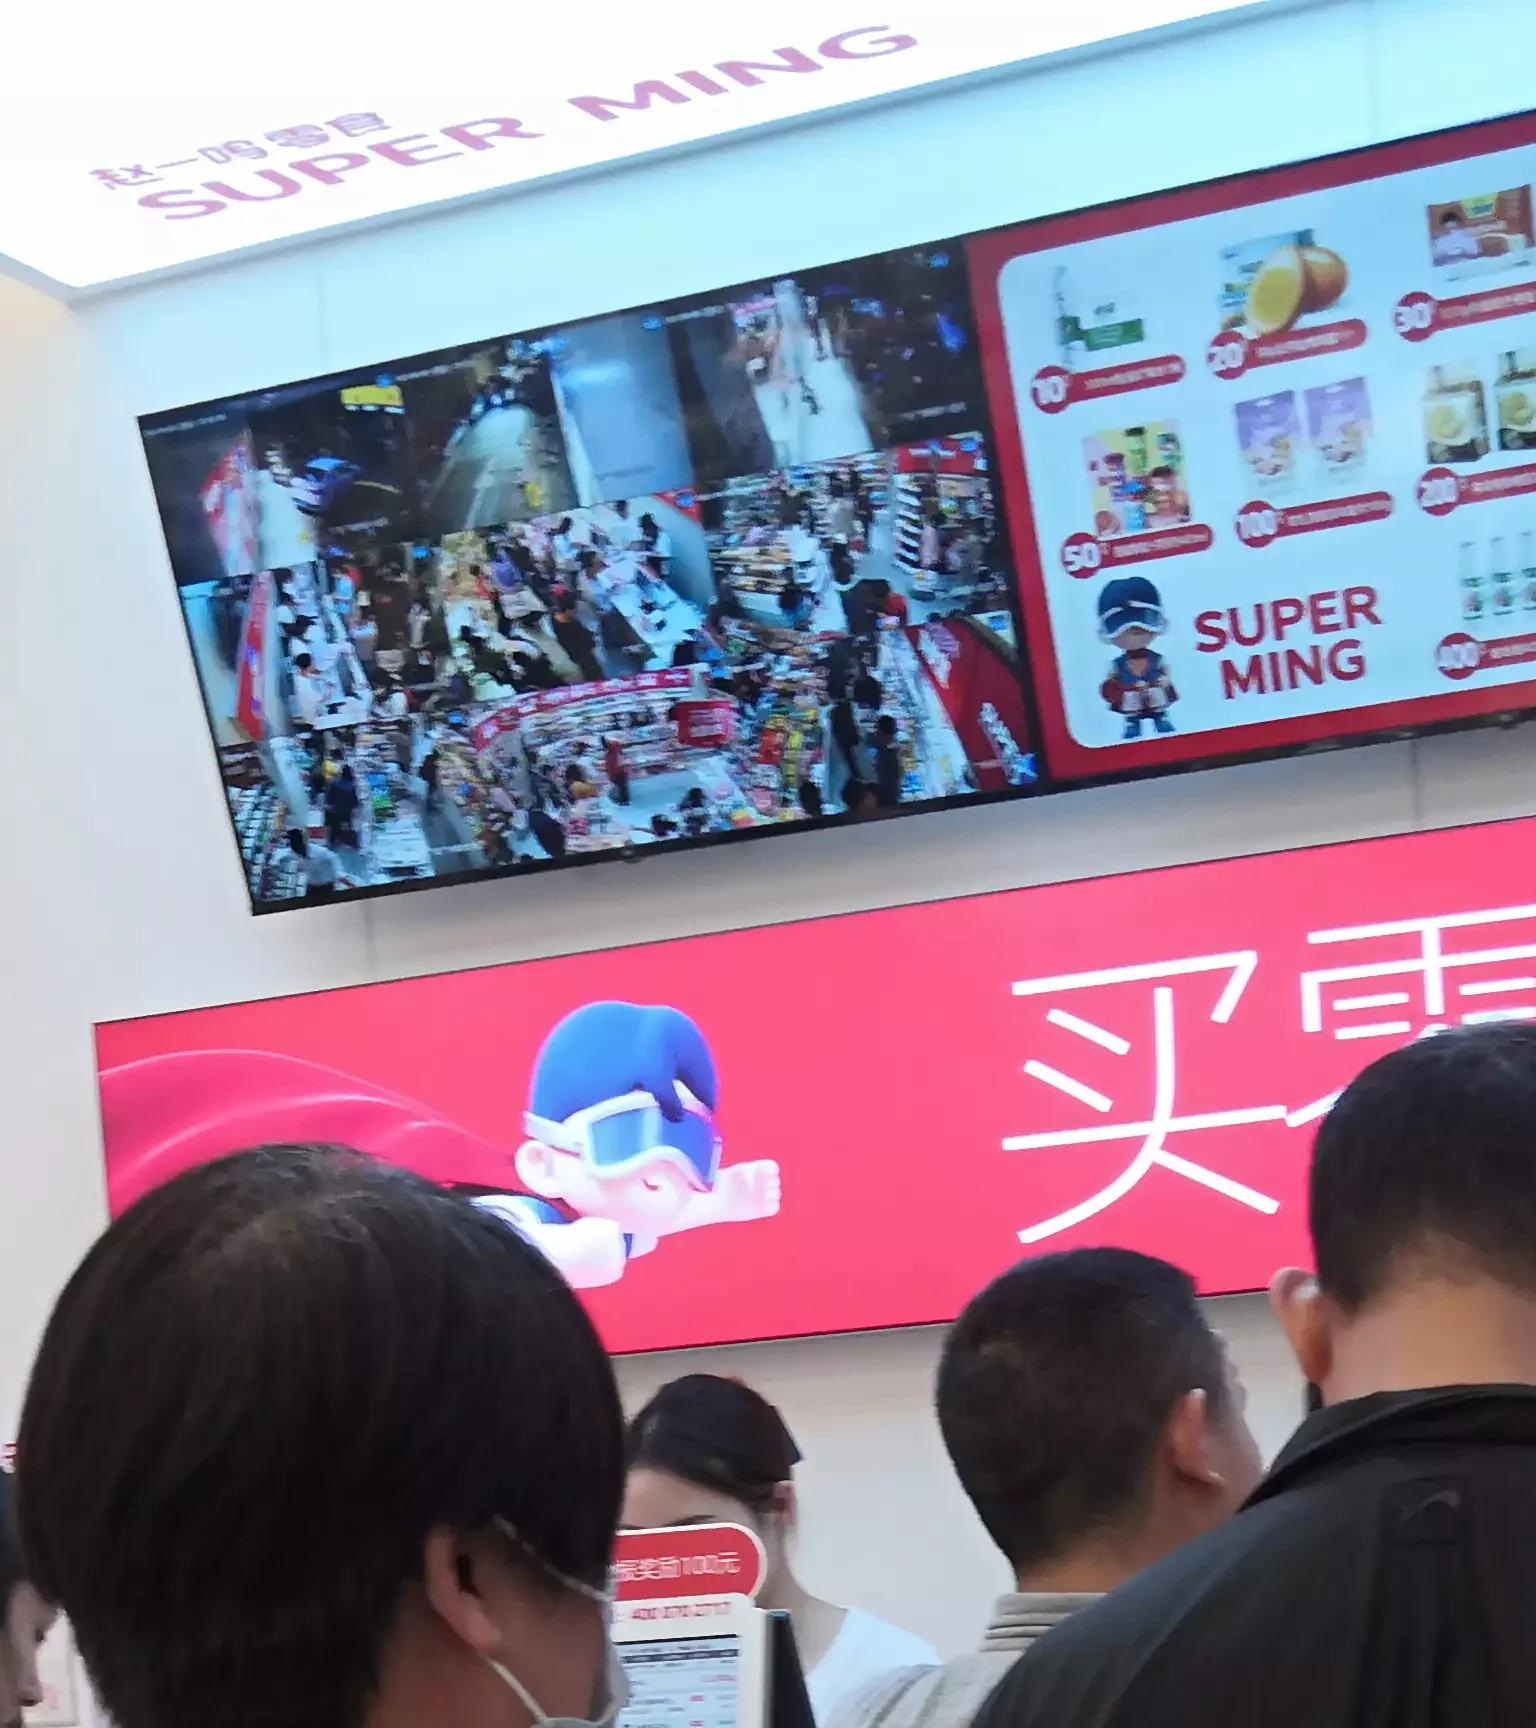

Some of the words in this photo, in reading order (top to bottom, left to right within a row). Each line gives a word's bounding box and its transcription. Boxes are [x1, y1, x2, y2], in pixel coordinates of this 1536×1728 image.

[137, 117, 544, 219] SUPER
[567, 24, 919, 120] MING
[1194, 585, 1383, 653] SUPER
[1220, 638, 1366, 700] MING
